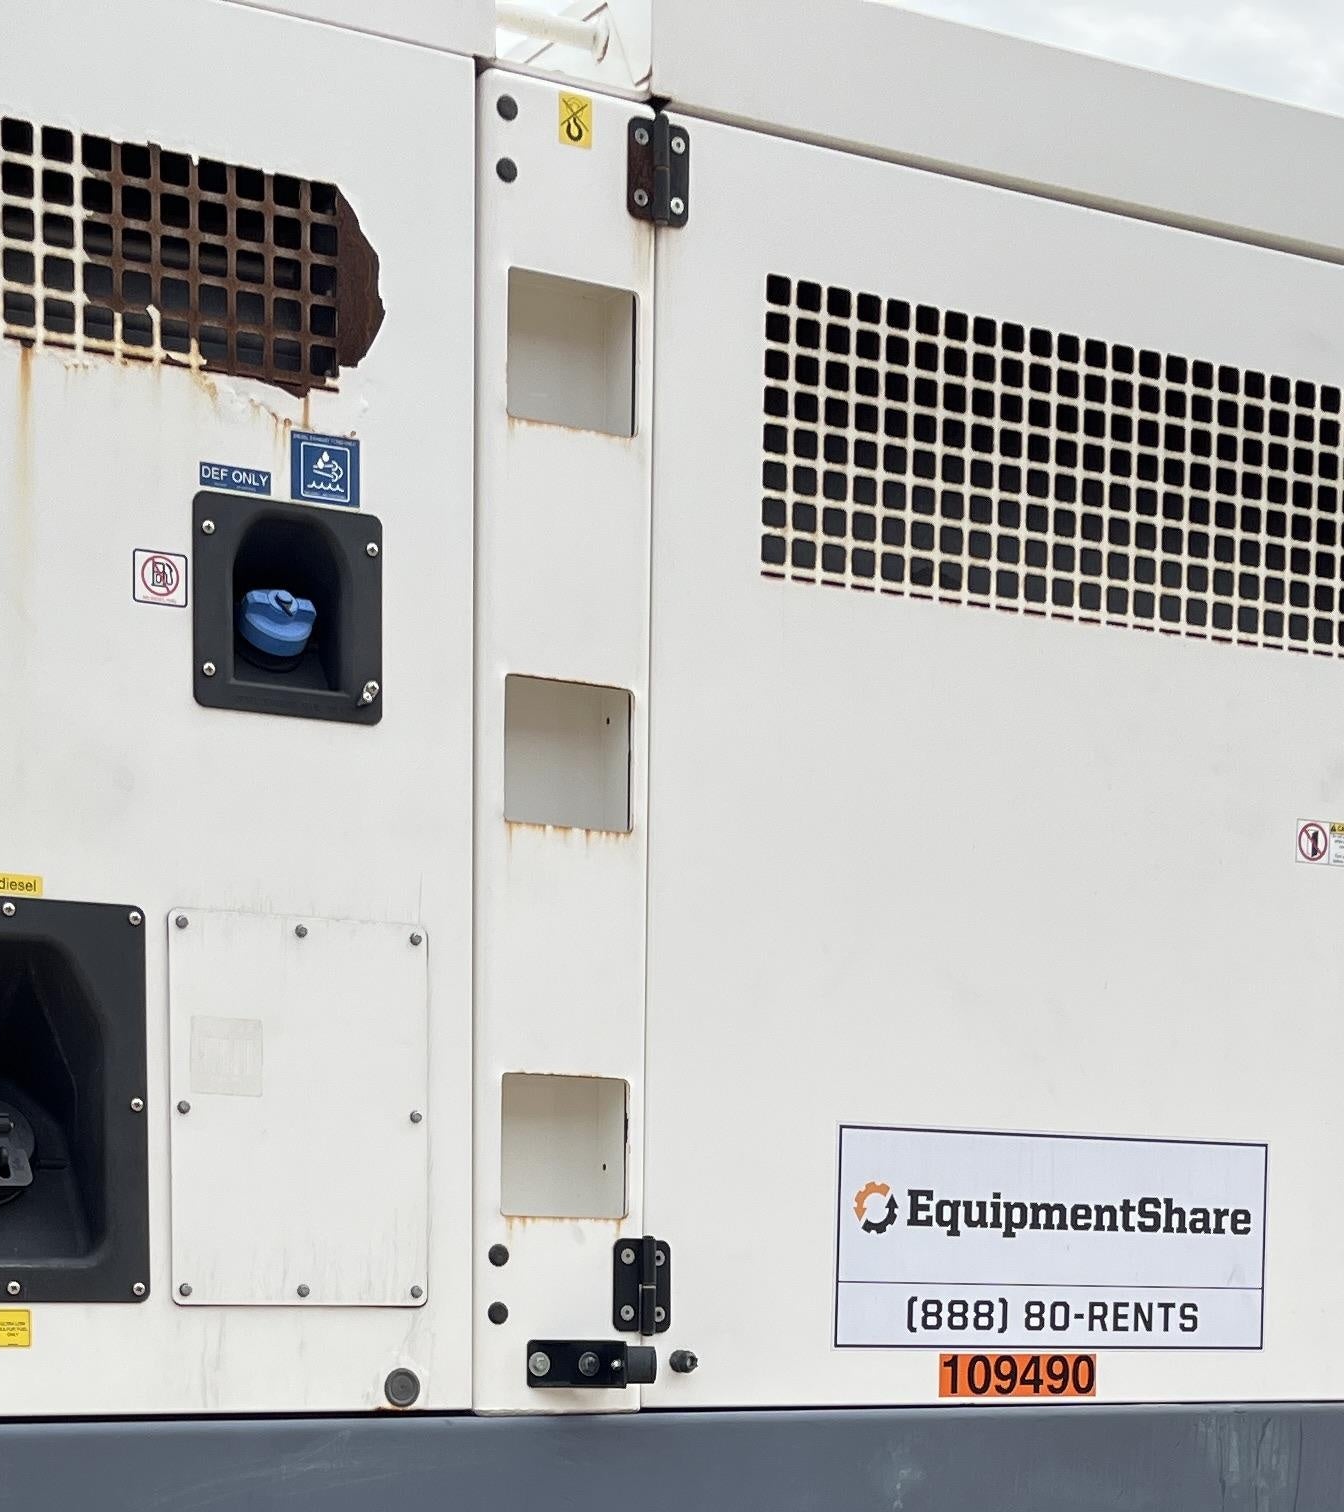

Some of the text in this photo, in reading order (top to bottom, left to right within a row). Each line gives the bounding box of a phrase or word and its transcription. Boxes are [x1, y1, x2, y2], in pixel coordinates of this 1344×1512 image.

[201, 465, 229, 481] DEF
[231, 470, 269, 487] ONLY
[906, 1188, 1252, 1238] EquipmentShare
[906, 1295, 1199, 1334] (888) 80-RENTS
[942, 1354, 1096, 1396] 109490
